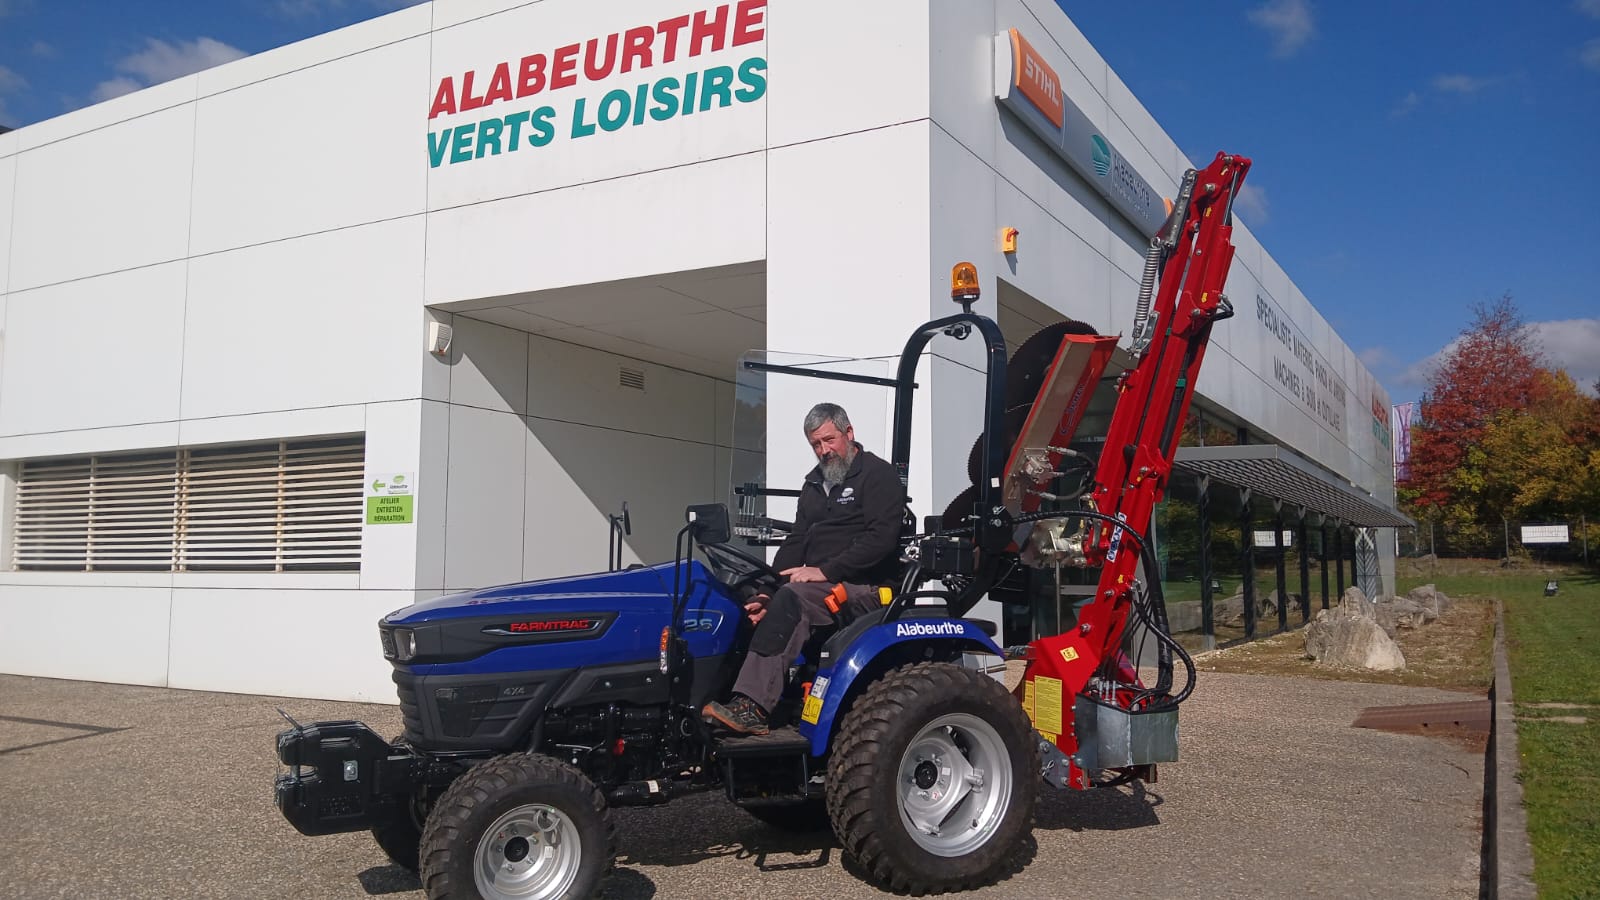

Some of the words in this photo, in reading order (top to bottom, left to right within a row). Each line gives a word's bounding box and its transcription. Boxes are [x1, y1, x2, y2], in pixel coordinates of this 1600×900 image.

[428, 0, 767, 119] ALABEURTHE
[1025, 53, 1059, 106] STIHL
[427, 106, 556, 168] VERTS
[571, 57, 768, 139] LOISIRS
[1256, 293, 1292, 351] SPECIALISTE
[510, 619, 589, 633] FARMTRAC
[896, 621, 965, 638] Alabeurthe
